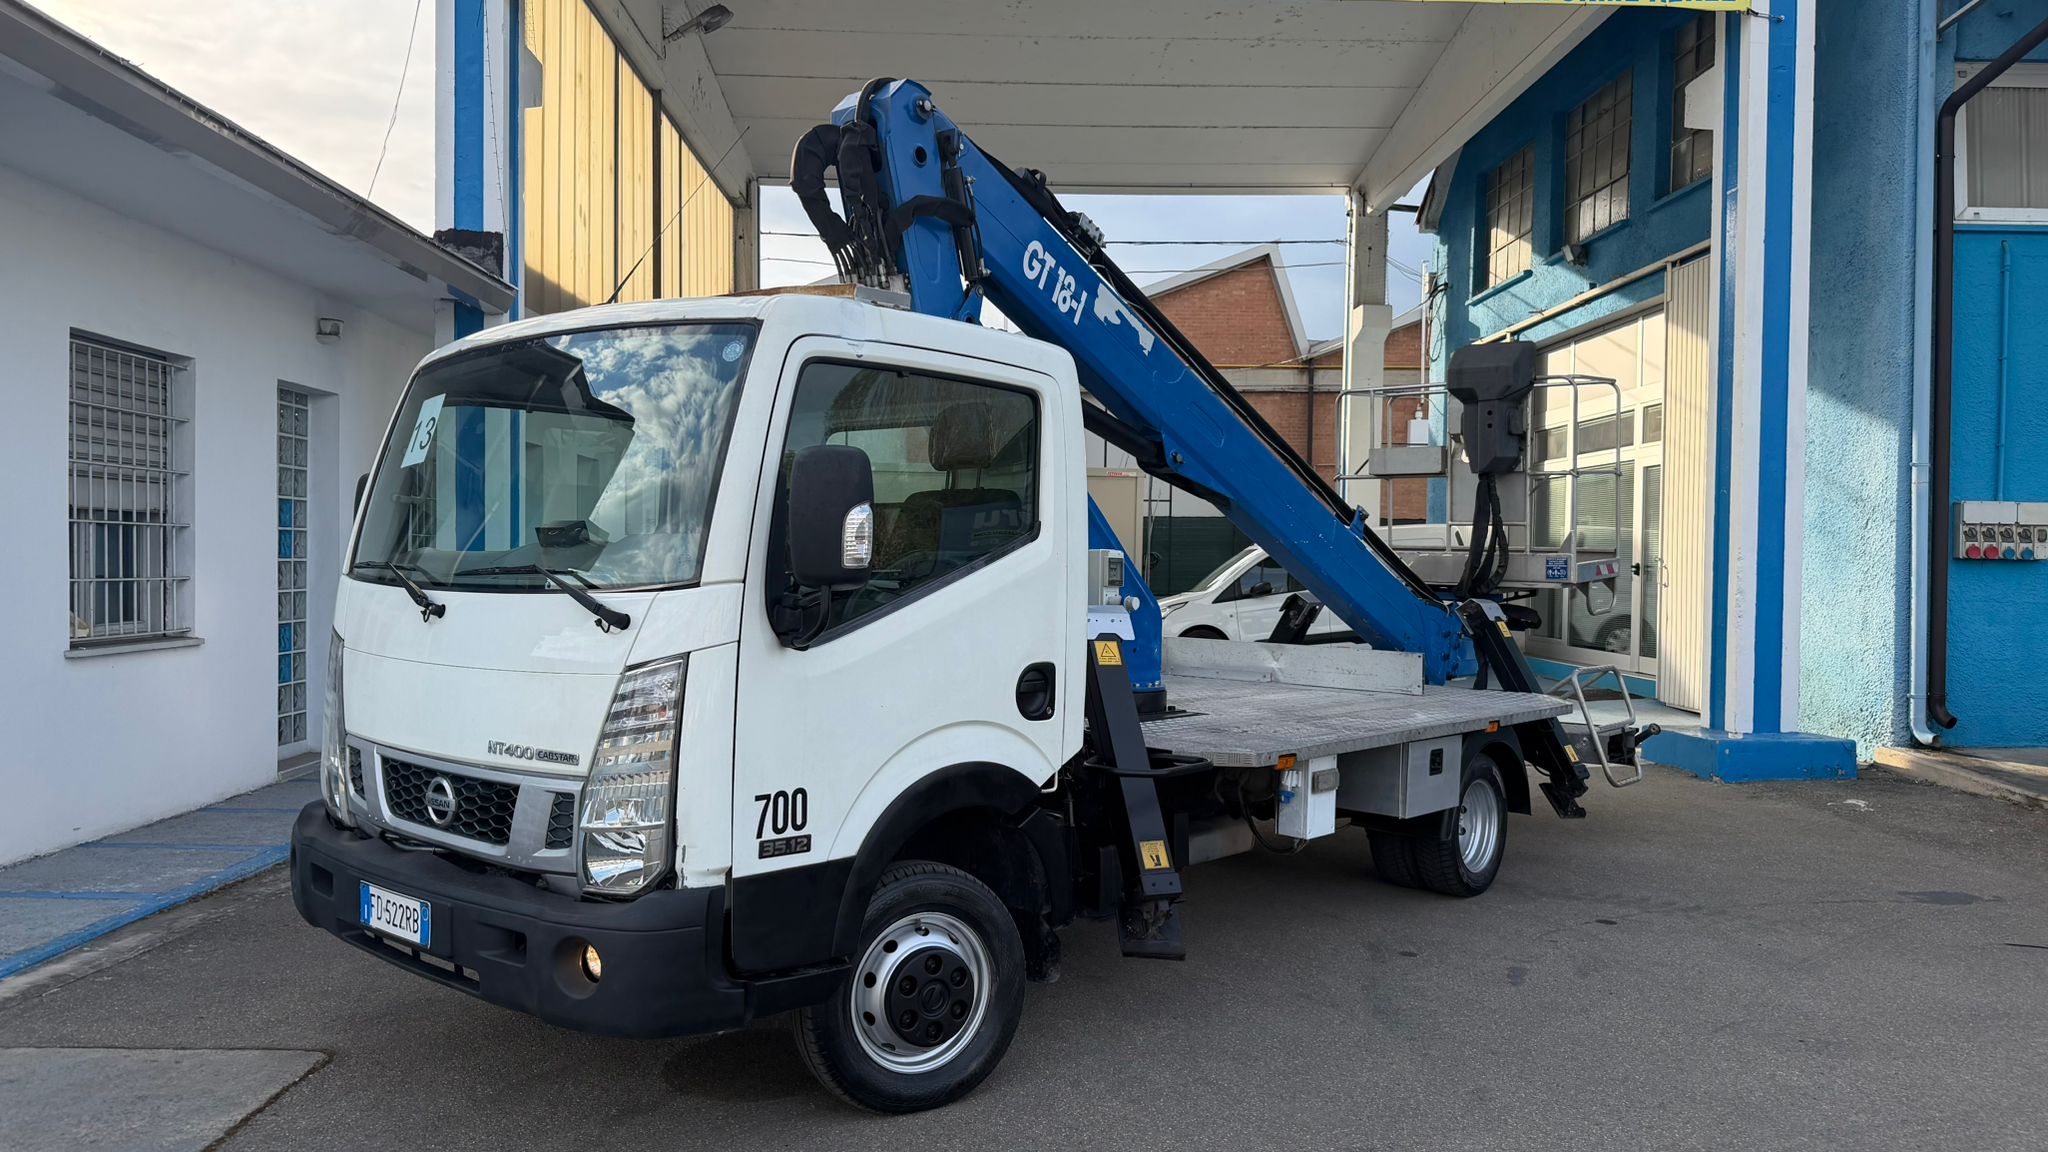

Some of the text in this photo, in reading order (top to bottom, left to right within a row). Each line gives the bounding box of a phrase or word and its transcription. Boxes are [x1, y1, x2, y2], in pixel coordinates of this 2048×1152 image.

[1022, 240, 1056, 291] GT
[410, 416, 436, 453] 13
[487, 739, 576, 763] NT400 CABSTAR
[754, 787, 808, 840] 700
[761, 837, 808, 857] 35.12
